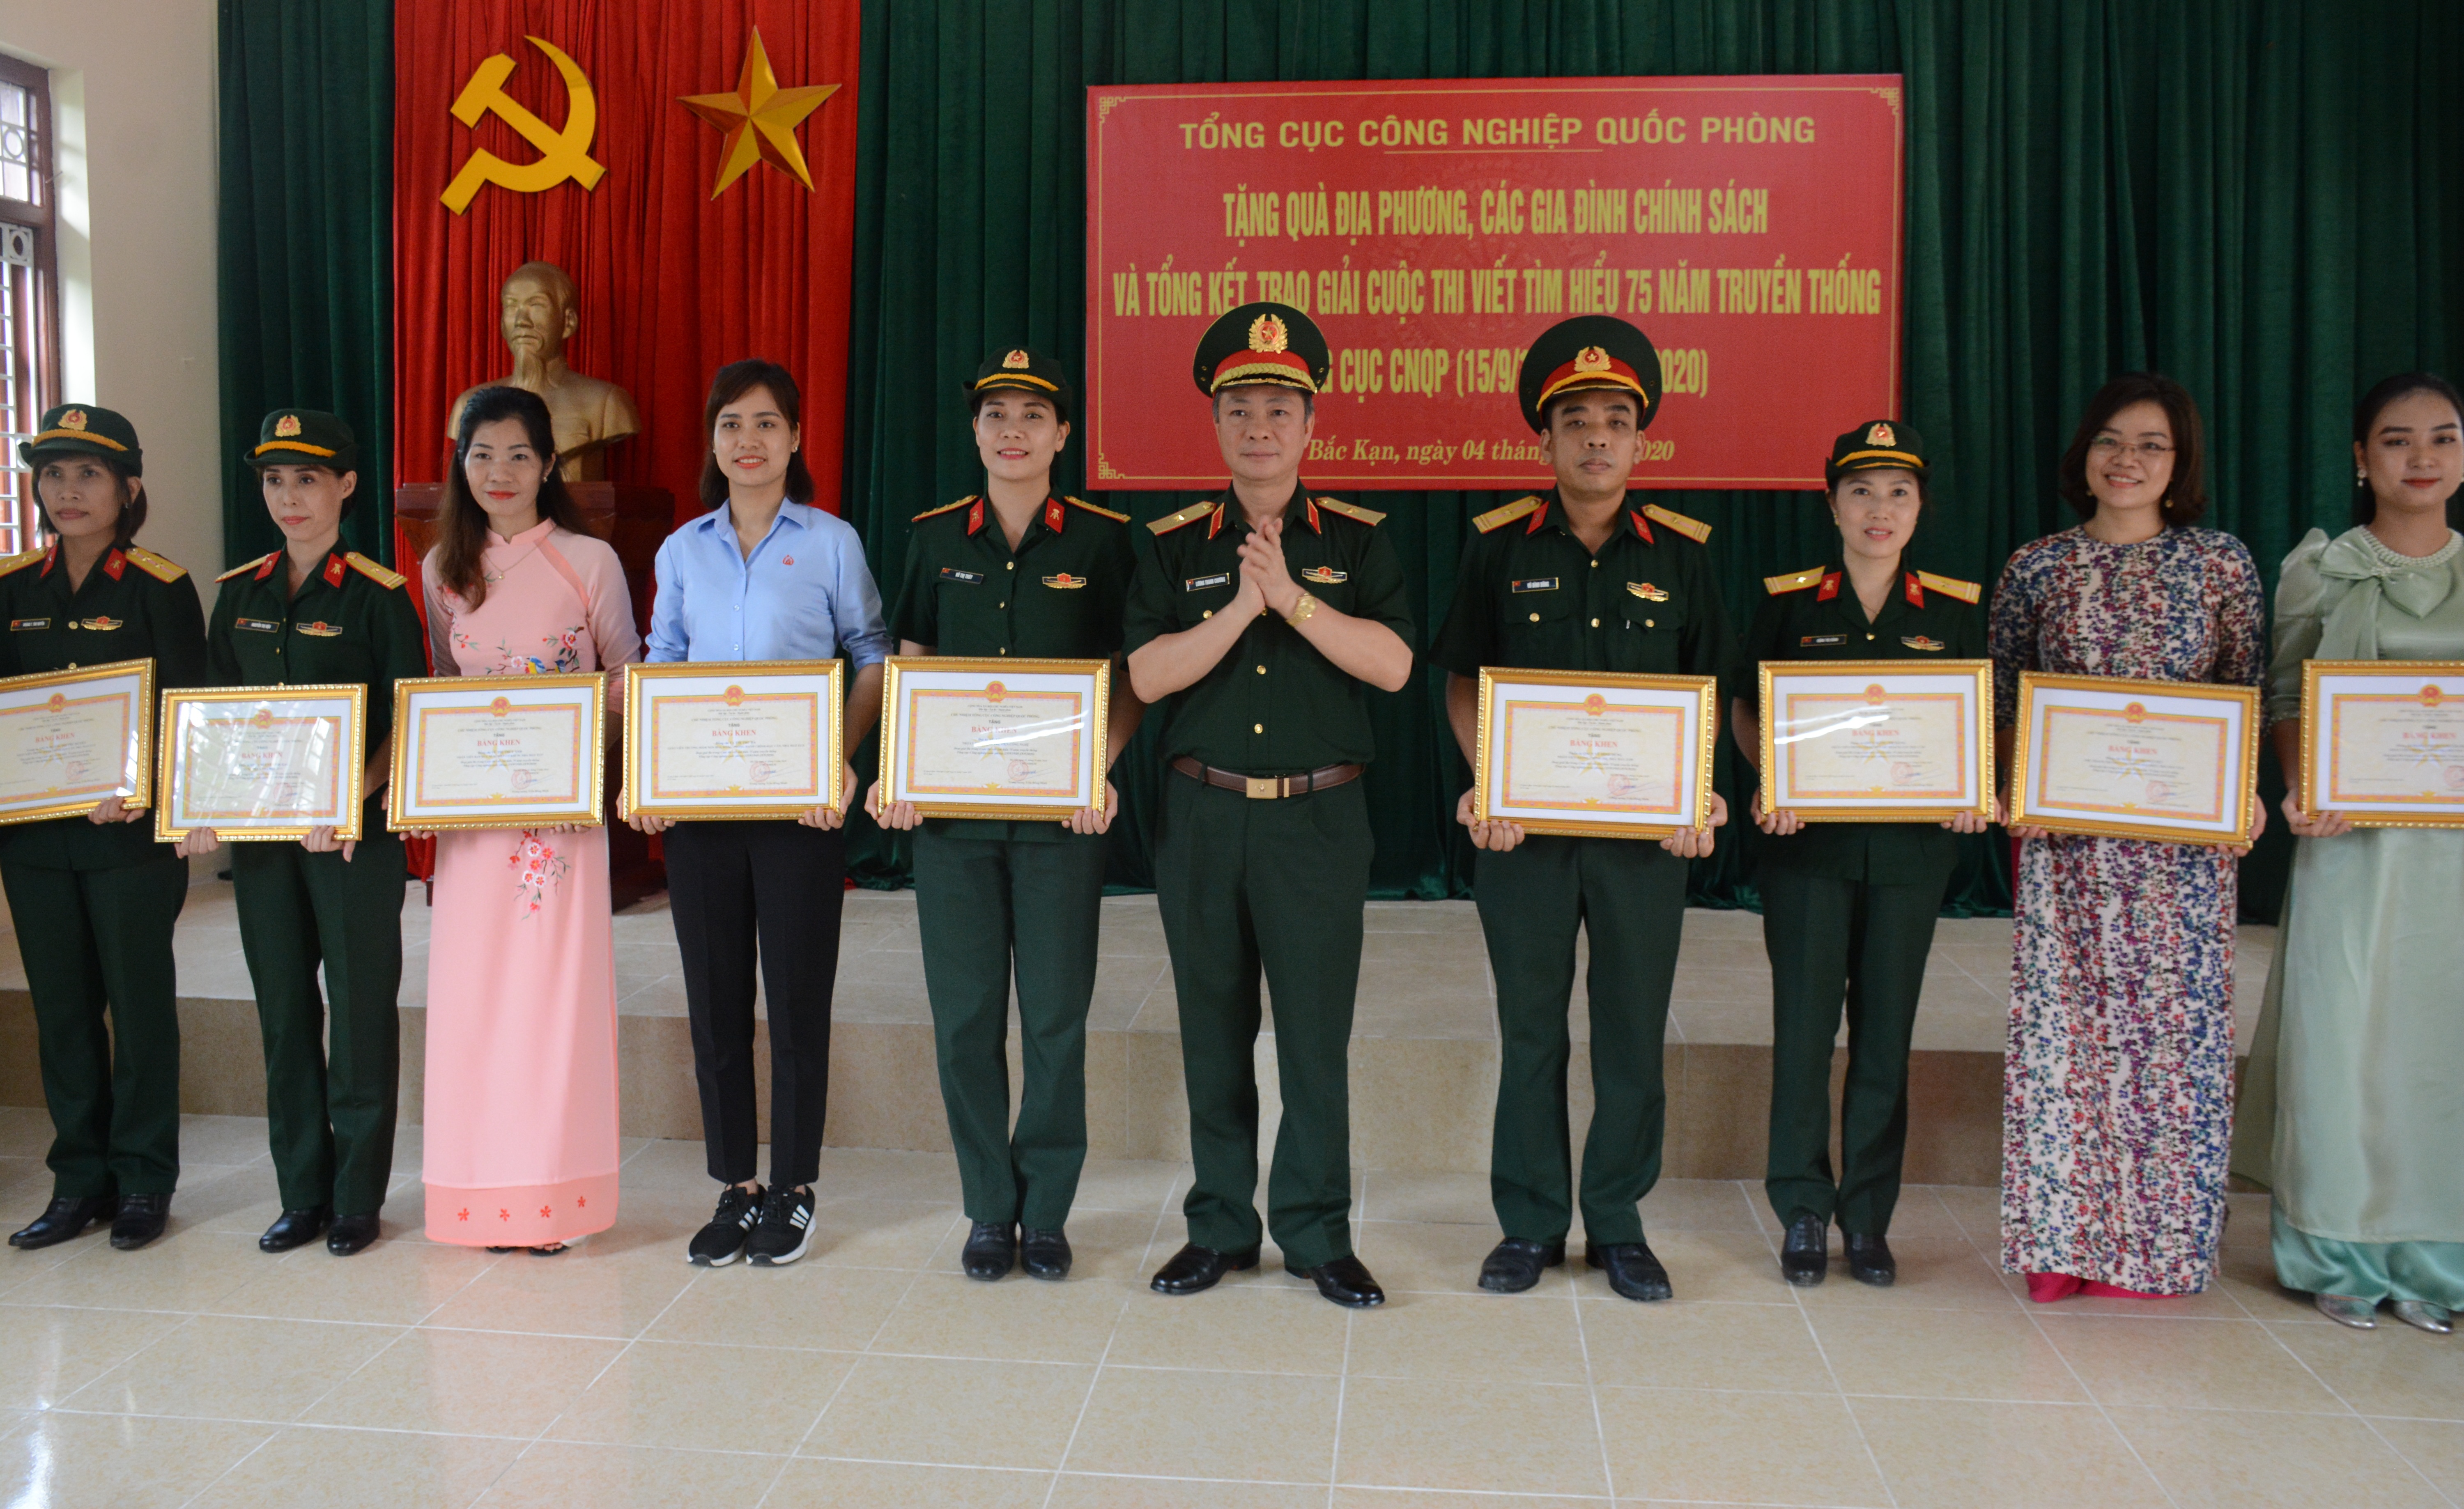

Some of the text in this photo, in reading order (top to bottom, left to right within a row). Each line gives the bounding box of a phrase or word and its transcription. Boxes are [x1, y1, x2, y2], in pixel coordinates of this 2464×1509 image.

[1179, 108, 1815, 152] TỔNG CỤC CÔNG NGHIỆP QUỐC PHÒNG
[1223, 179, 1768, 246] TẶNG QUÀ ĐỊA PHƯƠNG, CÁC GIA ĐÌNH CHÍNH SÁCH
[1113, 263, 1140, 316] VÀ
[1146, 254, 1202, 316] TỔNG
[1208, 257, 1248, 316] KẾT
[1317, 255, 1361, 315] GIẢI
[1367, 260, 1425, 324] CUỘC
[1431, 269, 1465, 314] THI
[1471, 254, 1517, 313] VIẾT
[1523, 259, 1563, 313] TÌM
[1570, 250, 1620, 314] HIỂU
[1626, 269, 1653, 314] 75
[1659, 259, 1710, 313] NĂM
[1717, 254, 1802, 314] TRUYỀN
[1808, 252, 1881, 314] THỐNG
[1340, 348, 1383, 403] CỤC
[1390, 348, 1449, 398] CNQP
[1308, 435, 1347, 460] Bắc
[1352, 439, 1400, 466] Kạn,
[1406, 439, 1458, 465] ngày
[1462, 439, 1485, 460] 04
